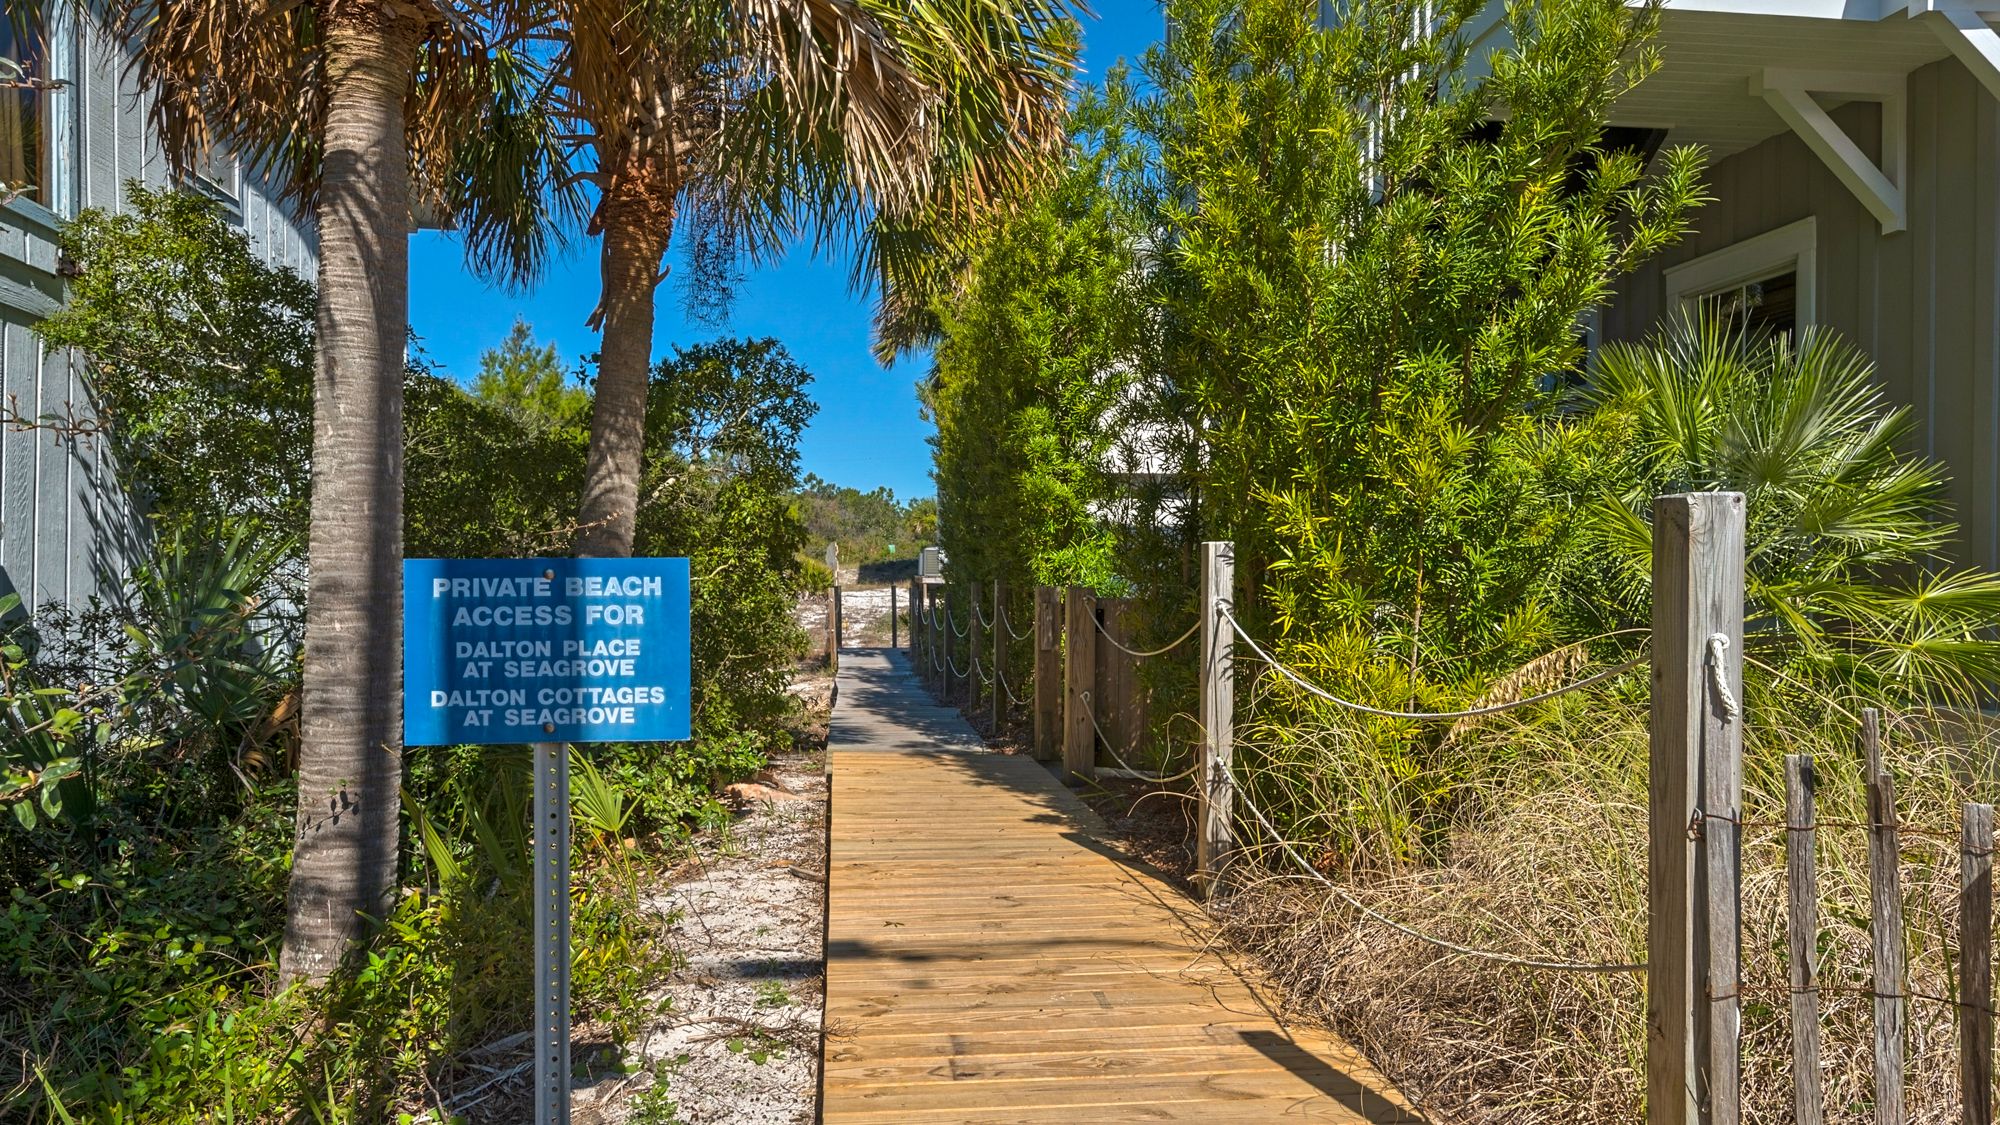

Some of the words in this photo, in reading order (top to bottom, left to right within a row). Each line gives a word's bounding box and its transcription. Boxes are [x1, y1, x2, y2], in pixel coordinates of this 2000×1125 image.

[433, 578, 551, 598] PRIVATE
[566, 577, 661, 596] BEACH
[453, 606, 572, 626] ACCESS
[586, 606, 644, 625] FOR
[456, 641, 551, 658] DALTON
[563, 640, 640, 657] PLACE
[463, 662, 493, 678] AT
[504, 660, 635, 677] SEAGROVE
[431, 689, 525, 707] DALTON
[538, 687, 664, 705] COTTAGES
[463, 710, 493, 726] AT
[505, 707, 635, 726] SEAGROVE
